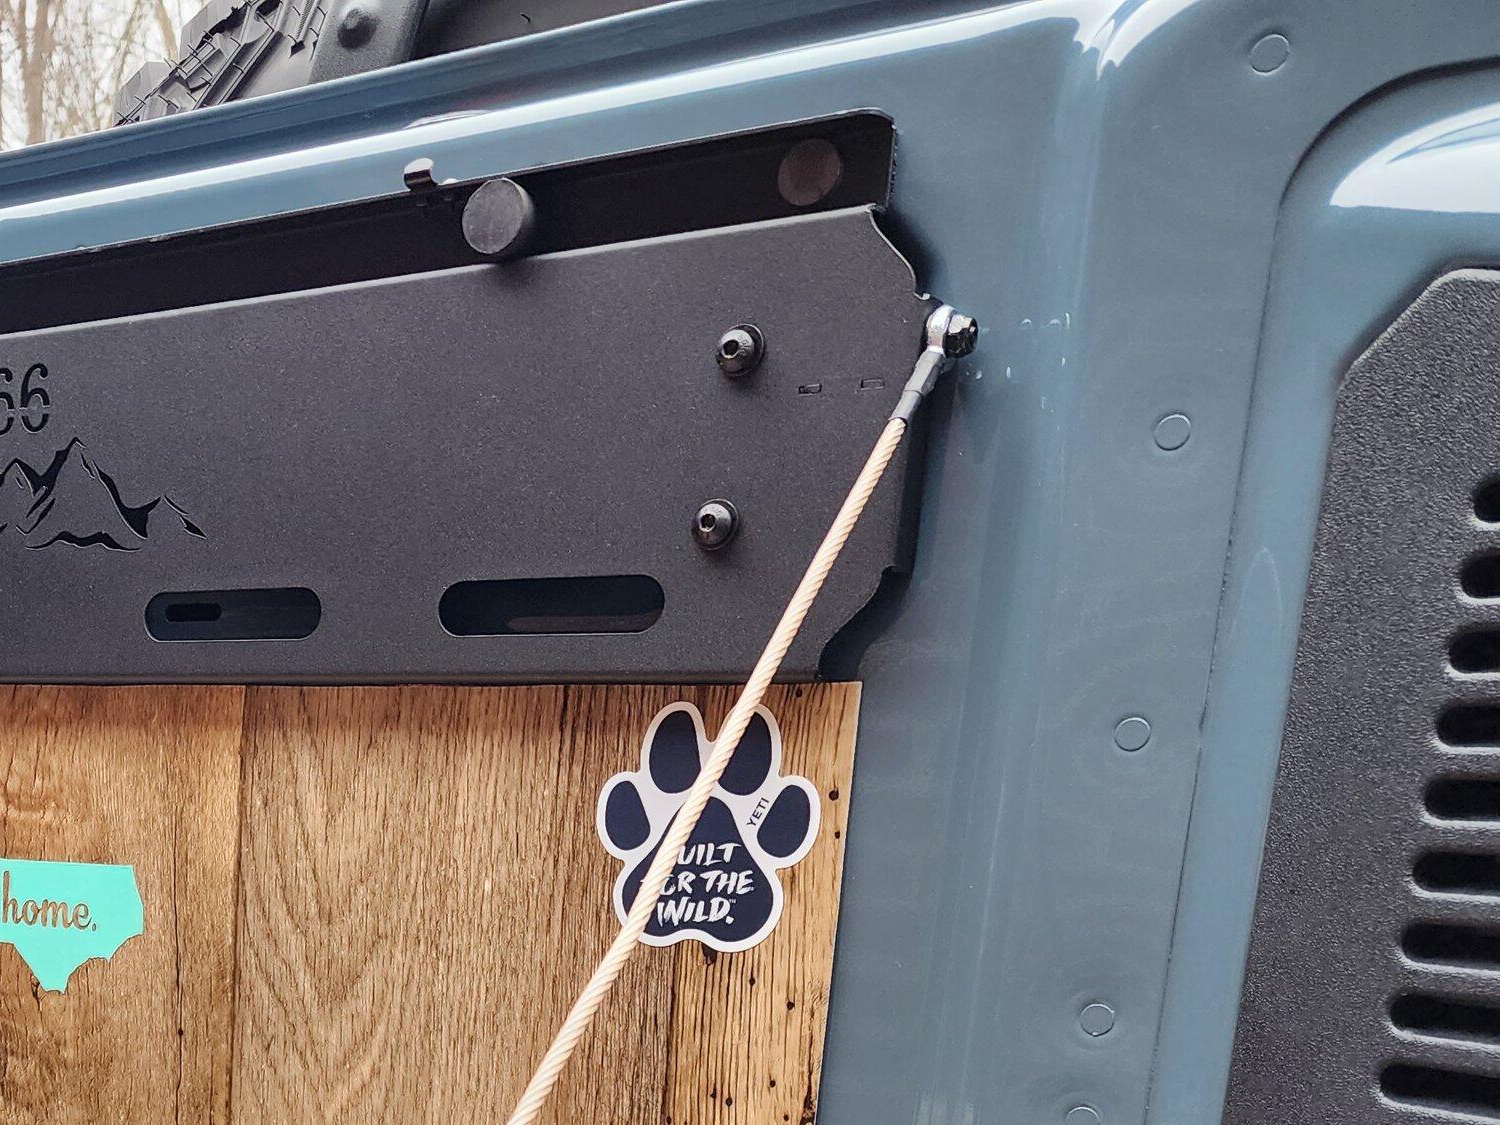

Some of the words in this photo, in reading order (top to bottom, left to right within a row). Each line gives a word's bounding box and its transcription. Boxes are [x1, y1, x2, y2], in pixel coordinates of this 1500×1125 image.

[746, 797, 770, 826] YETI
[672, 842, 742, 866] UILT
[700, 869, 755, 895] THE
[1, 870, 97, 932] home.
[657, 896, 735, 927] WILD.
